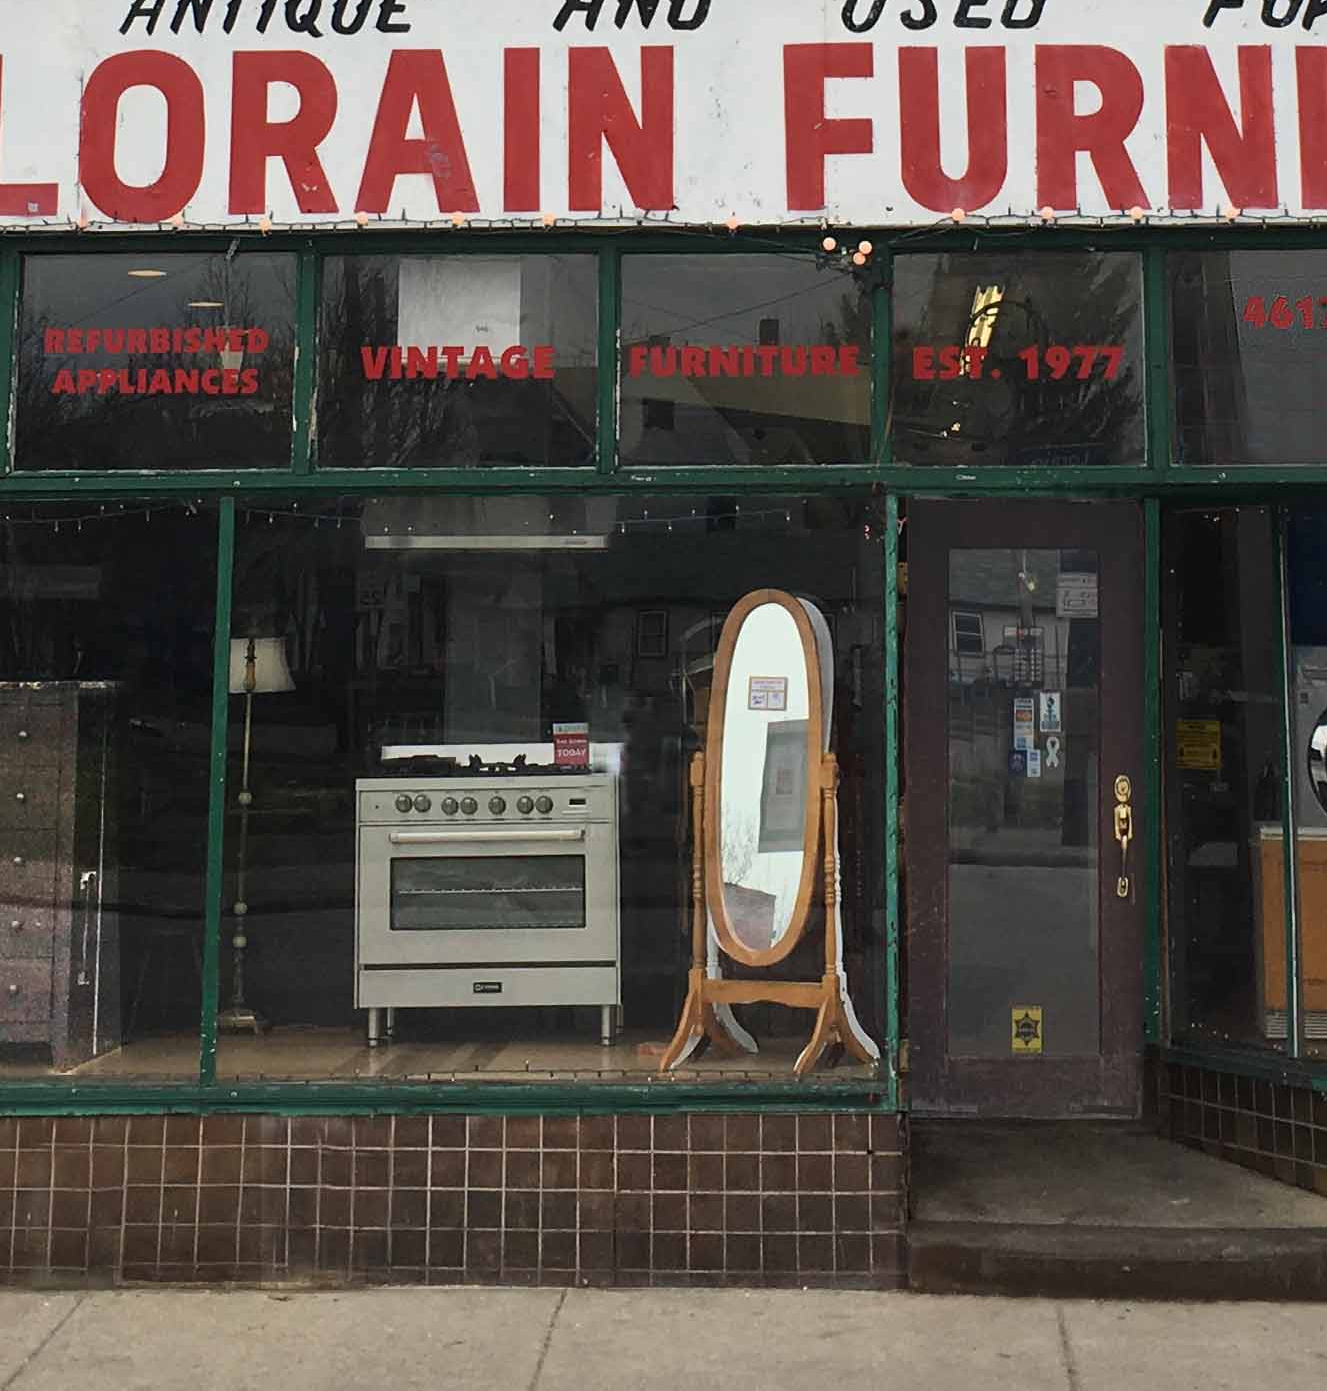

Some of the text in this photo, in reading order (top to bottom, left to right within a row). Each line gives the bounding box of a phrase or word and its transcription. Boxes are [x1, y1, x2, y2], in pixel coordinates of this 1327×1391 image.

[44, 327, 270, 354] REFURBISHED
[360, 344, 556, 381] VINTAGE
[629, 344, 861, 378] FURNITURE
[912, 344, 1125, 381] EST. 1977
[51, 367, 258, 395] APPLIANCES
